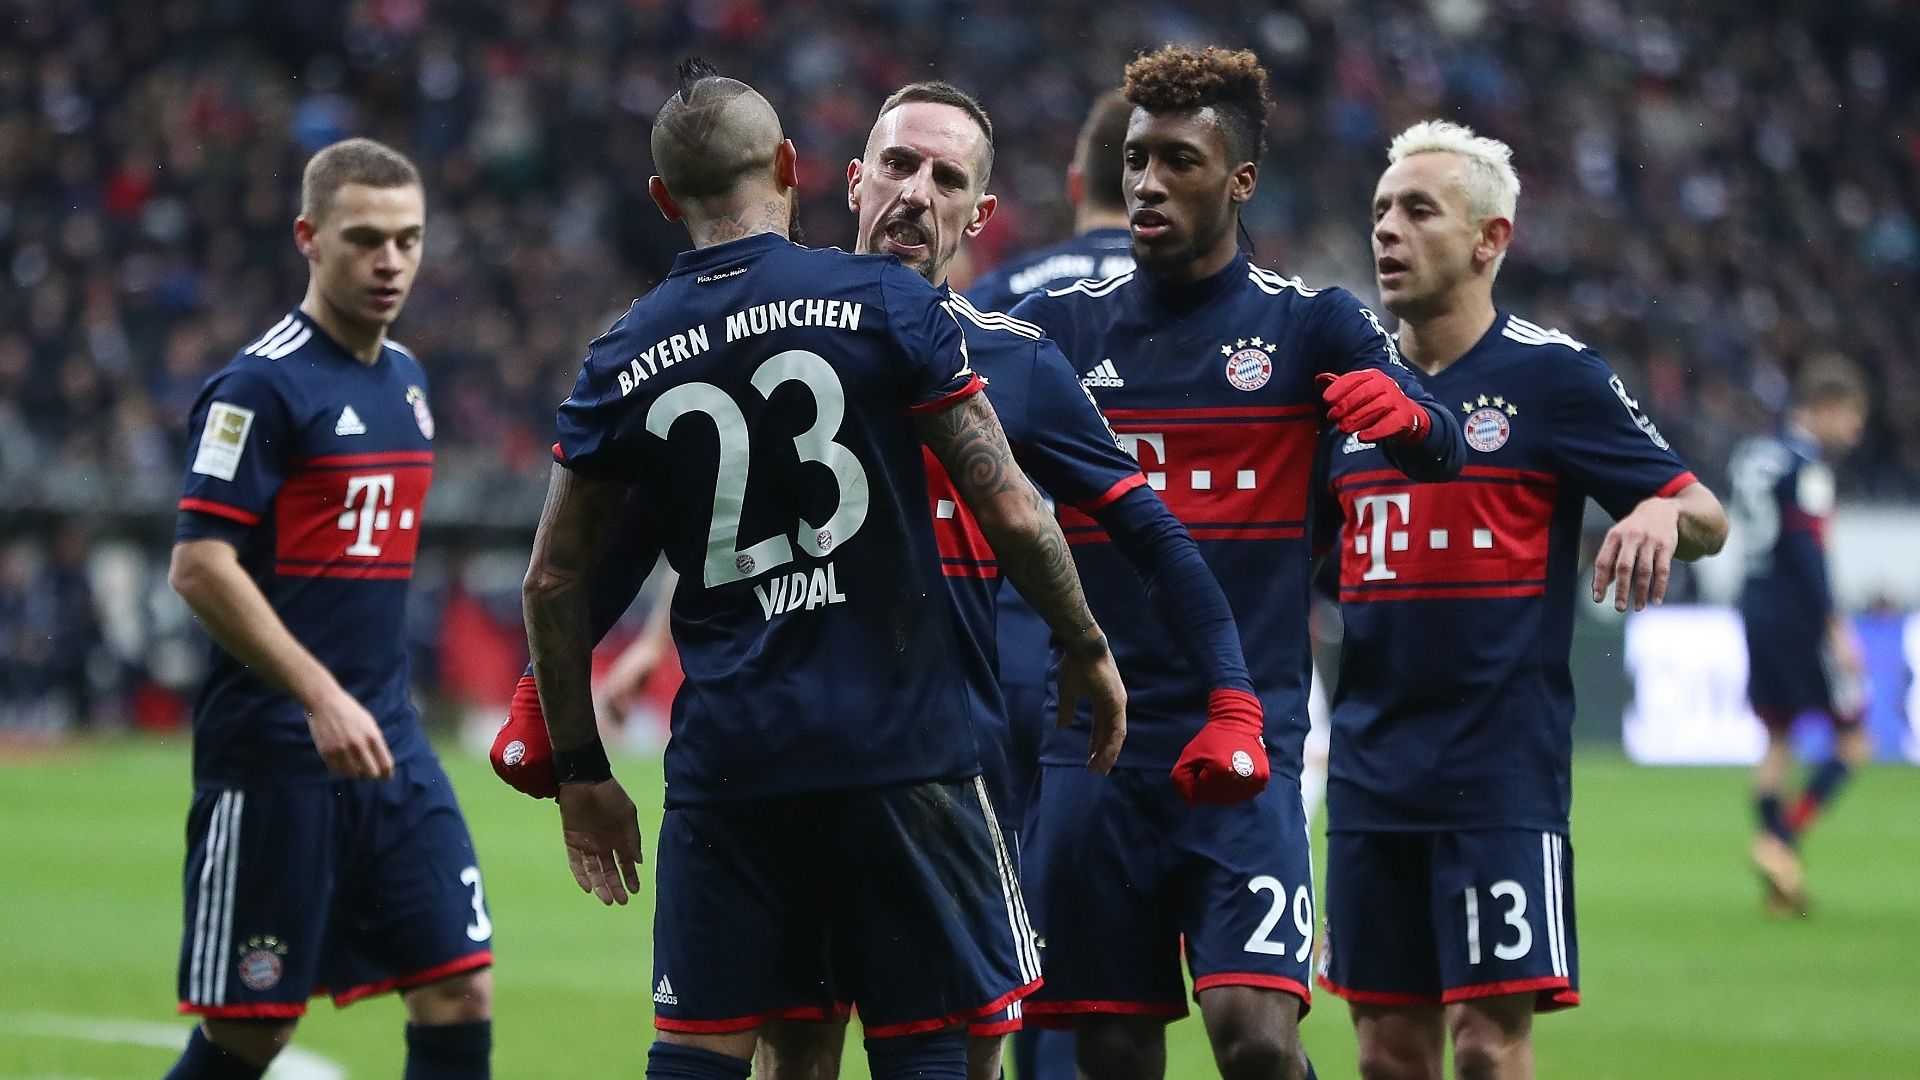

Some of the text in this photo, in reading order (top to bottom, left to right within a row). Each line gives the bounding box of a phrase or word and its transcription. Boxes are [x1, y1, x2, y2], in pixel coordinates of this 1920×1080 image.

[697, 267, 748, 284] Mia san mia
[617, 298, 863, 398] BAYERN MÜNCHEN
[1081, 375, 1125, 388] adidas
[645, 349, 870, 589] 23
[753, 562, 847, 622] VIDAL
[460, 866, 493, 943] 3
[1244, 875, 1313, 964] 29
[1464, 880, 1534, 966] 13
[653, 992, 678, 1006] adidas
